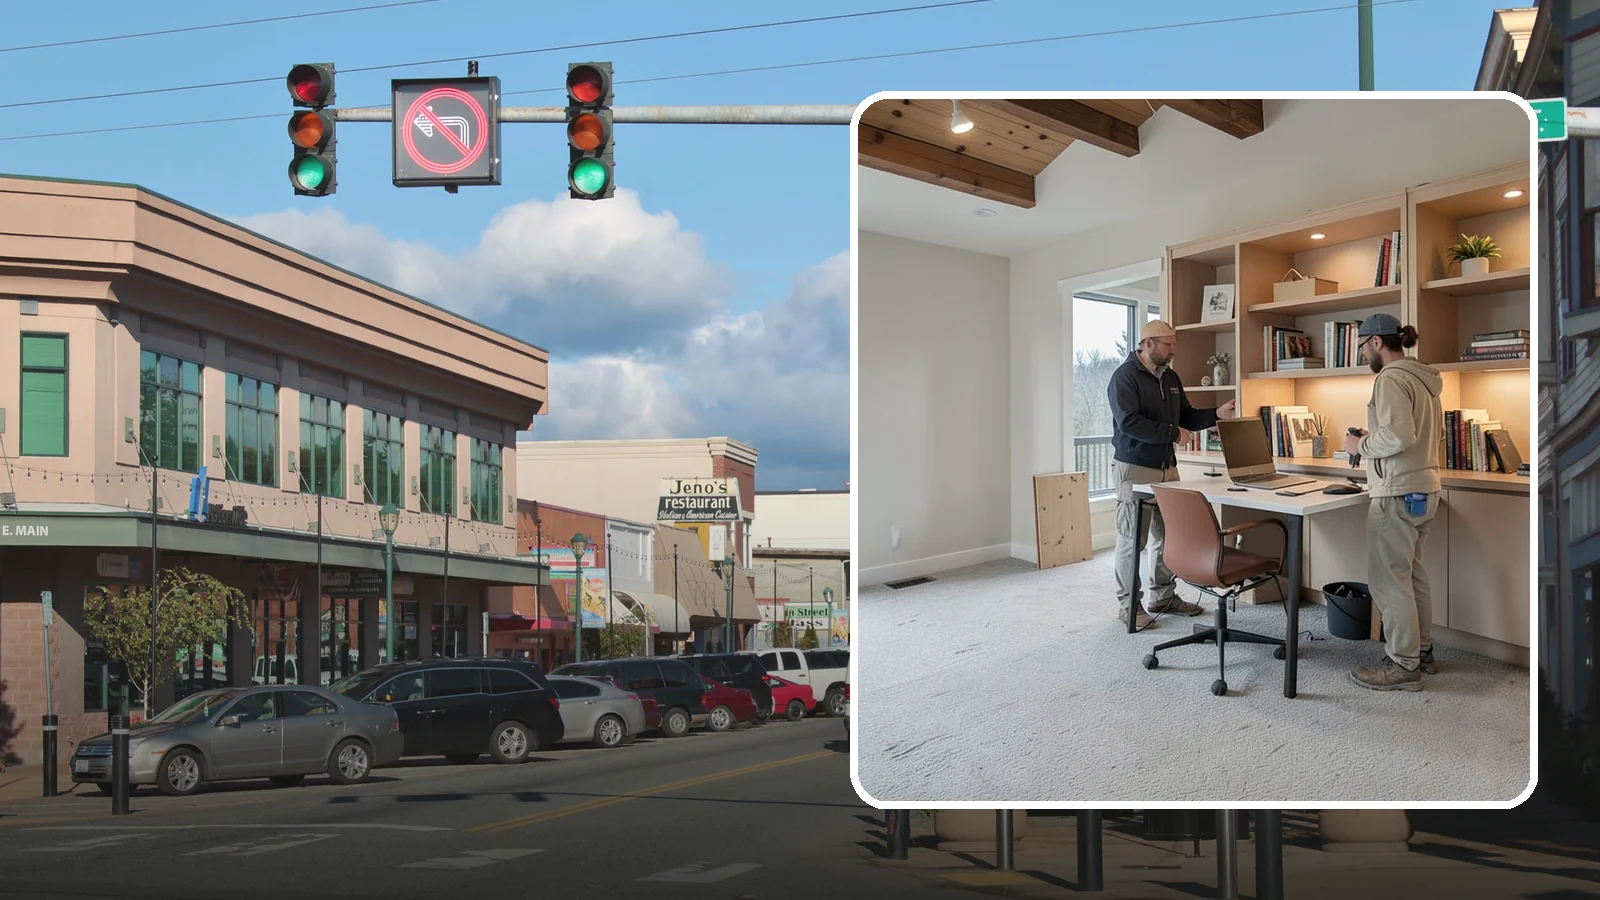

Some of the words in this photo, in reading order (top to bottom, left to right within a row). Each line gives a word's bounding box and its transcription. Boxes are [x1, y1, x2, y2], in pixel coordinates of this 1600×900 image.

[669, 480, 728, 495] Jeno's
[665, 496, 731, 509] restaurant
[685, 509, 715, 520] American
[714, 509, 738, 520] Cuisine
[2, 525, 13, 536] E.
[15, 525, 49, 536] MAIN
[797, 608, 829, 617] Street
